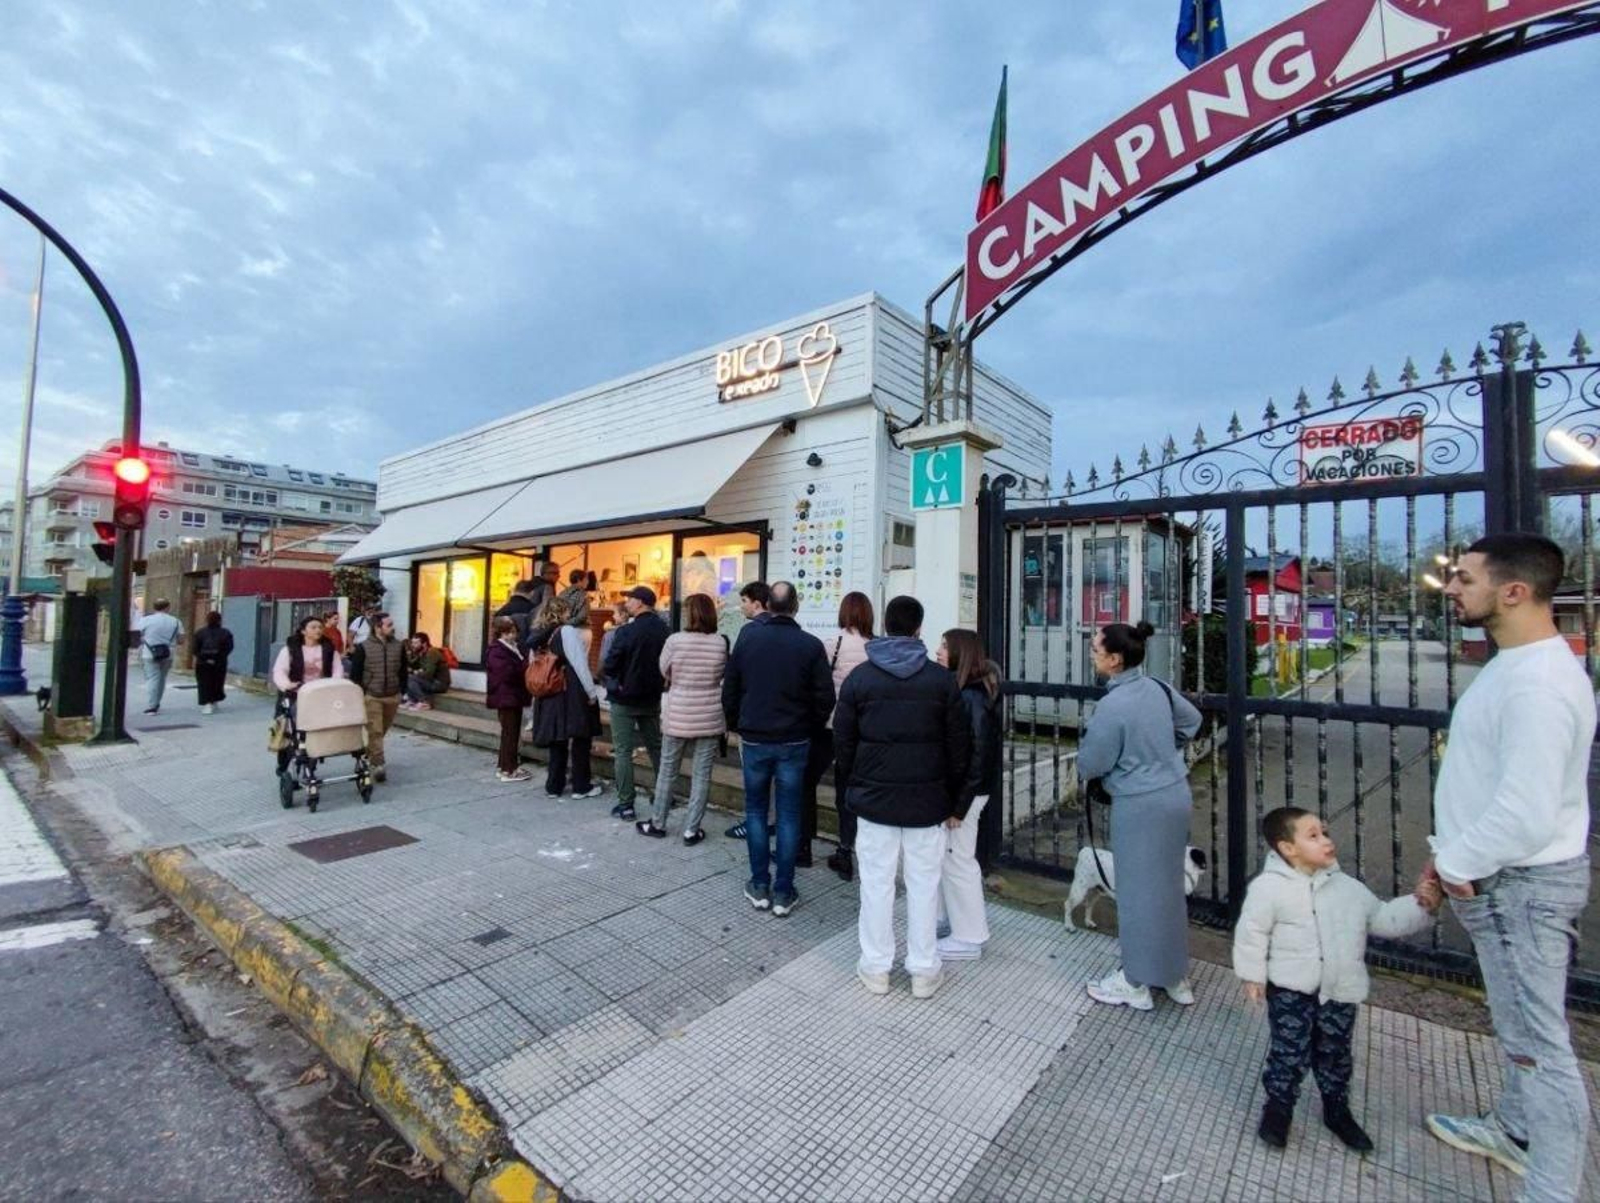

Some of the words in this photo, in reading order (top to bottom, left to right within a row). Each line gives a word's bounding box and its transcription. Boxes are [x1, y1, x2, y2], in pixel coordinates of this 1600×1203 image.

[977, 31, 1316, 281] CAMPING
[716, 336, 782, 384] BICO
[1305, 420, 1418, 449] CERRADO
[926, 452, 948, 482] C
[1342, 448, 1377, 462] POR
[1306, 462, 1415, 480] VACACIONES
